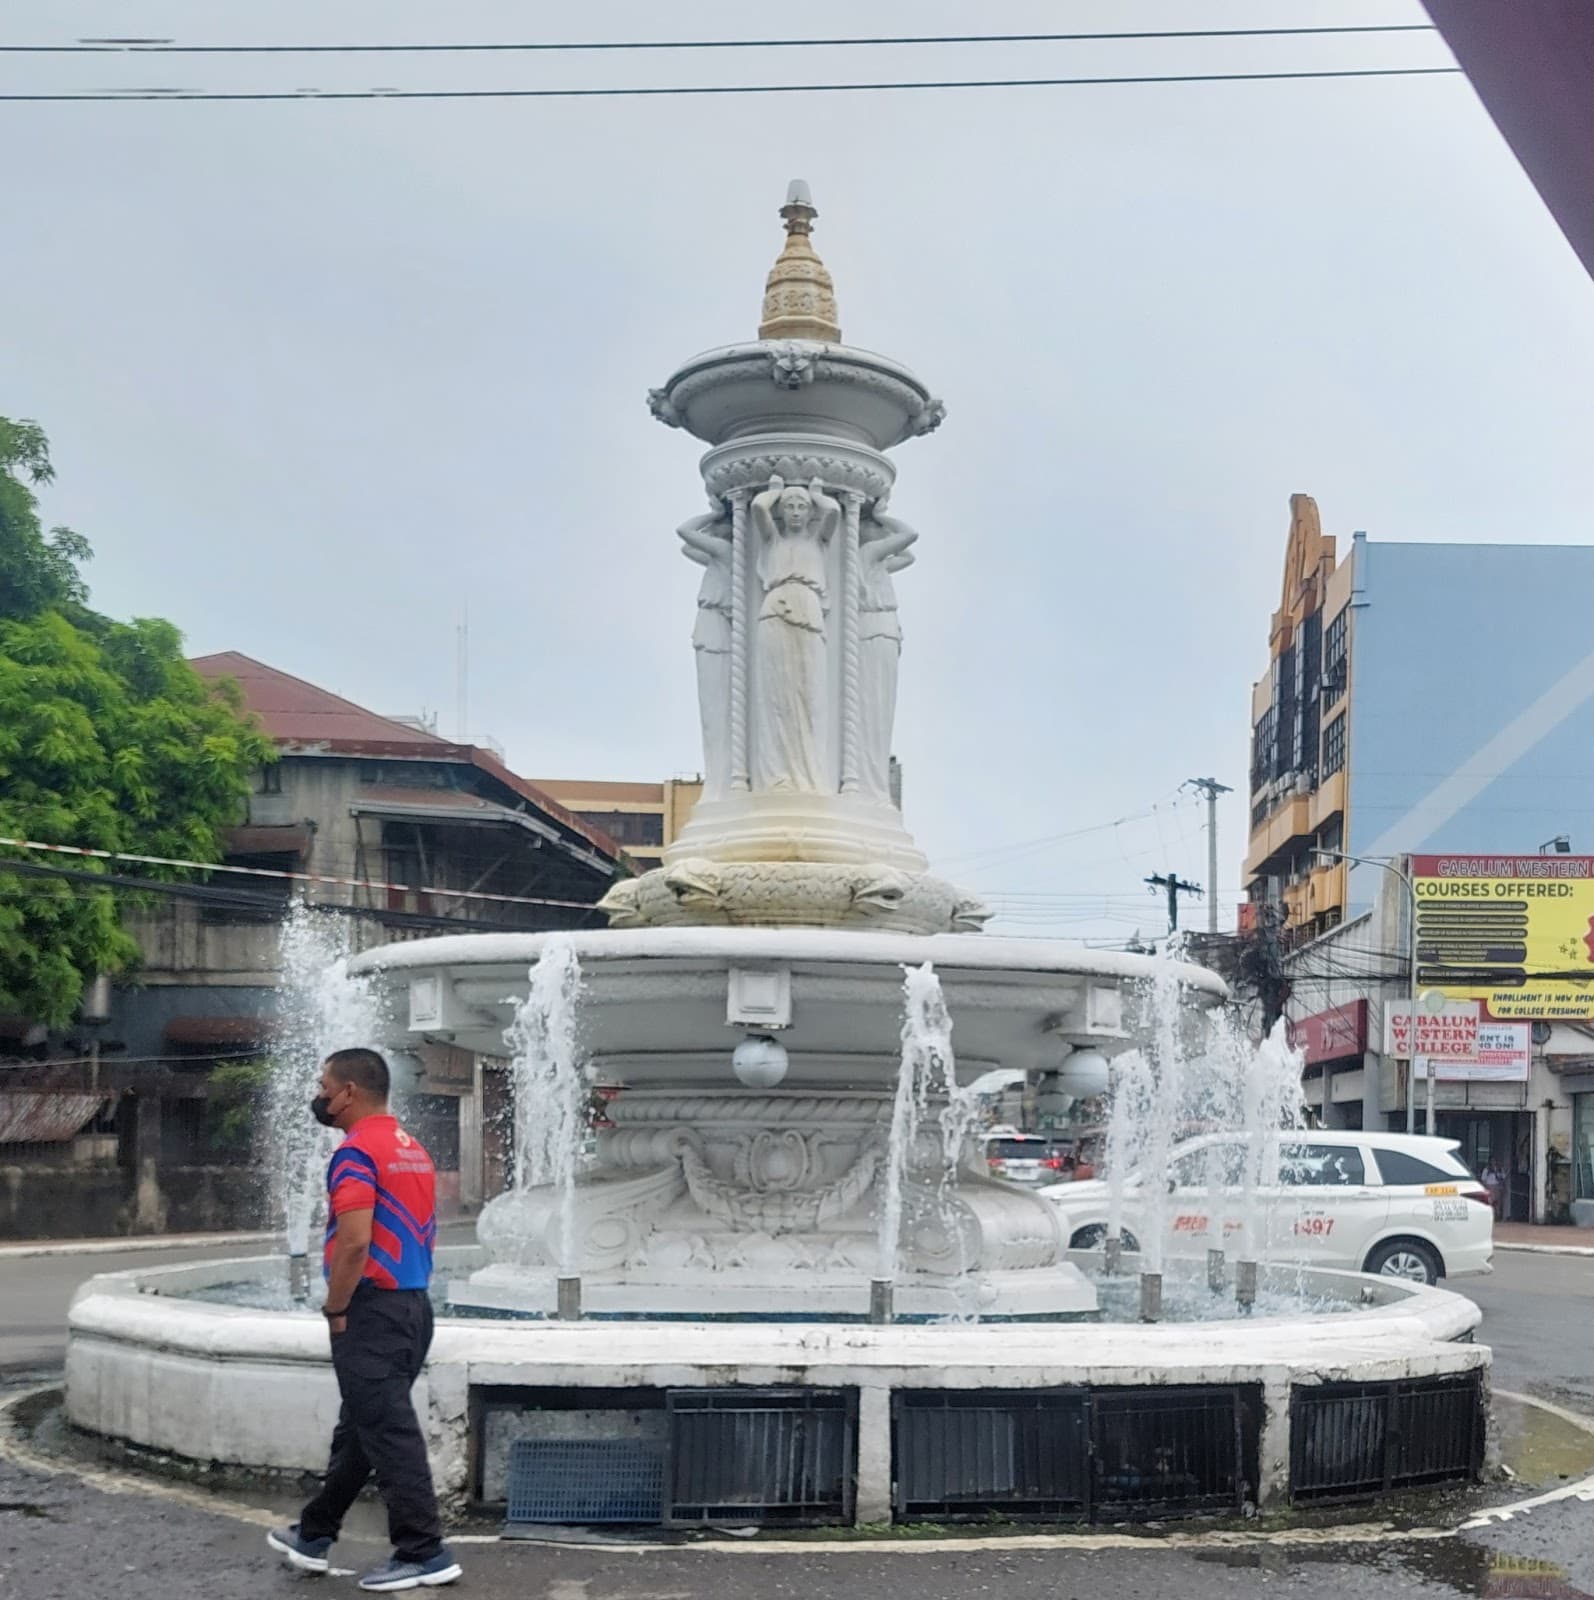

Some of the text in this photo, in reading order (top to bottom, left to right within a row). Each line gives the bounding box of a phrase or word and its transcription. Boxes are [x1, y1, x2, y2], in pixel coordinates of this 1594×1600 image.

[1438, 859, 1513, 877] CABALUM
[1516, 860, 1589, 877] WESTERN
[1416, 882, 1574, 897] COURSES OFFERED:
[1493, 993, 1542, 1002] ENROLLMENT
[1545, 994, 1552, 1002] IS
[1555, 994, 1572, 1002] NOW
[1497, 1007, 1590, 1016] FOR COLLEGE FRESHMEN!
[1392, 1016, 1477, 1027] CABALUM
[1396, 1042, 1473, 1053] COLLEGE
